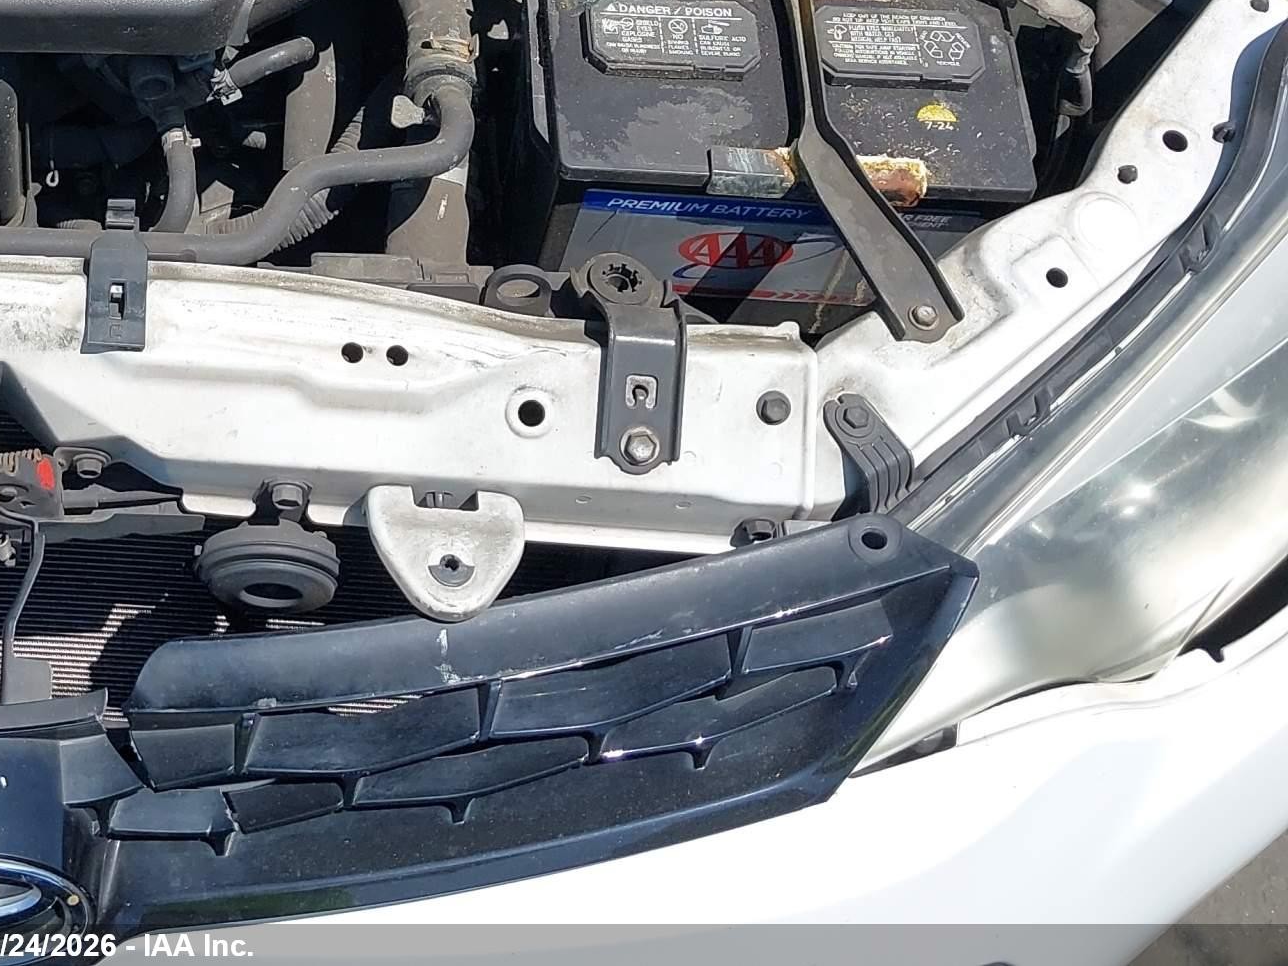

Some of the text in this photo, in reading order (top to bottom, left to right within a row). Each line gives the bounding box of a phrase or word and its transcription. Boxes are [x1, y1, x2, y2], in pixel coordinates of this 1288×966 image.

[619, 4, 672, 15] DANGER
[685, 7, 733, 17] POISON
[607, 198, 813, 219] PREMIUM BATTERY
[684, 233, 791, 268] AAA
